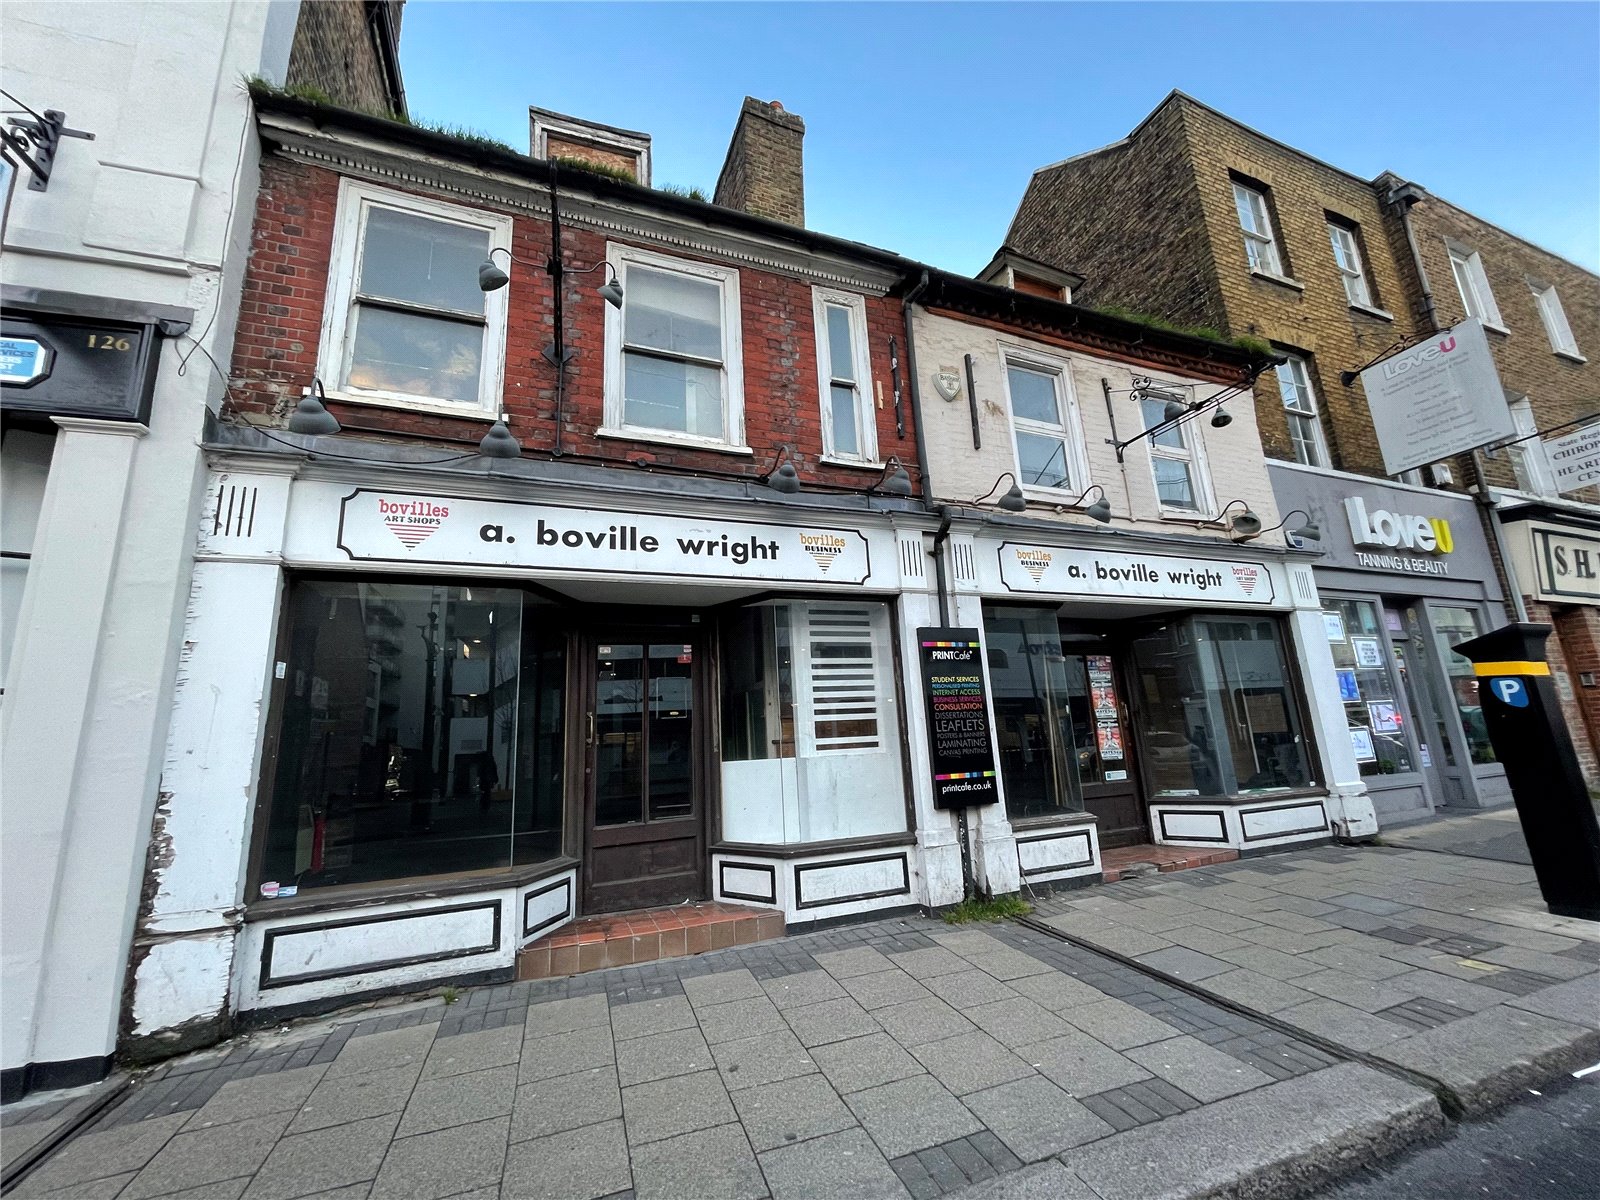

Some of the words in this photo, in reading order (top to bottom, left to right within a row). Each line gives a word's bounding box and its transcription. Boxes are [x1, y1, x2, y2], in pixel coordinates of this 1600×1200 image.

[87, 334, 130, 351] 126
[379, 499, 449, 518] bovilles
[384, 515, 405, 523] ART
[407, 516, 441, 526] SHOPS
[479, 523, 516, 544] a.
[536, 519, 660, 553] boville
[676, 533, 780, 565] wright
[799, 533, 846, 548] bovilles
[805, 545, 842, 554] BUSINESS
[1016, 549, 1052, 561] bovilles
[1355, 552, 1403, 570] TANNING
[1403, 557, 1412, 571] &
[1411, 558, 1449, 575] BEAUTY
[1067, 562, 1087, 580] a.
[1095, 560, 1160, 583] boville
[1167, 567, 1223, 591] wright
[1498, 679, 1520, 703] P
[934, 703, 983, 711] CONSULTATION
[935, 711, 984, 719] DISSERTATIONS
[936, 719, 985, 732] LEAFLETS
[938, 738, 987, 749] LAMINATING
[942, 780, 992, 795] printcafe.co.uk
